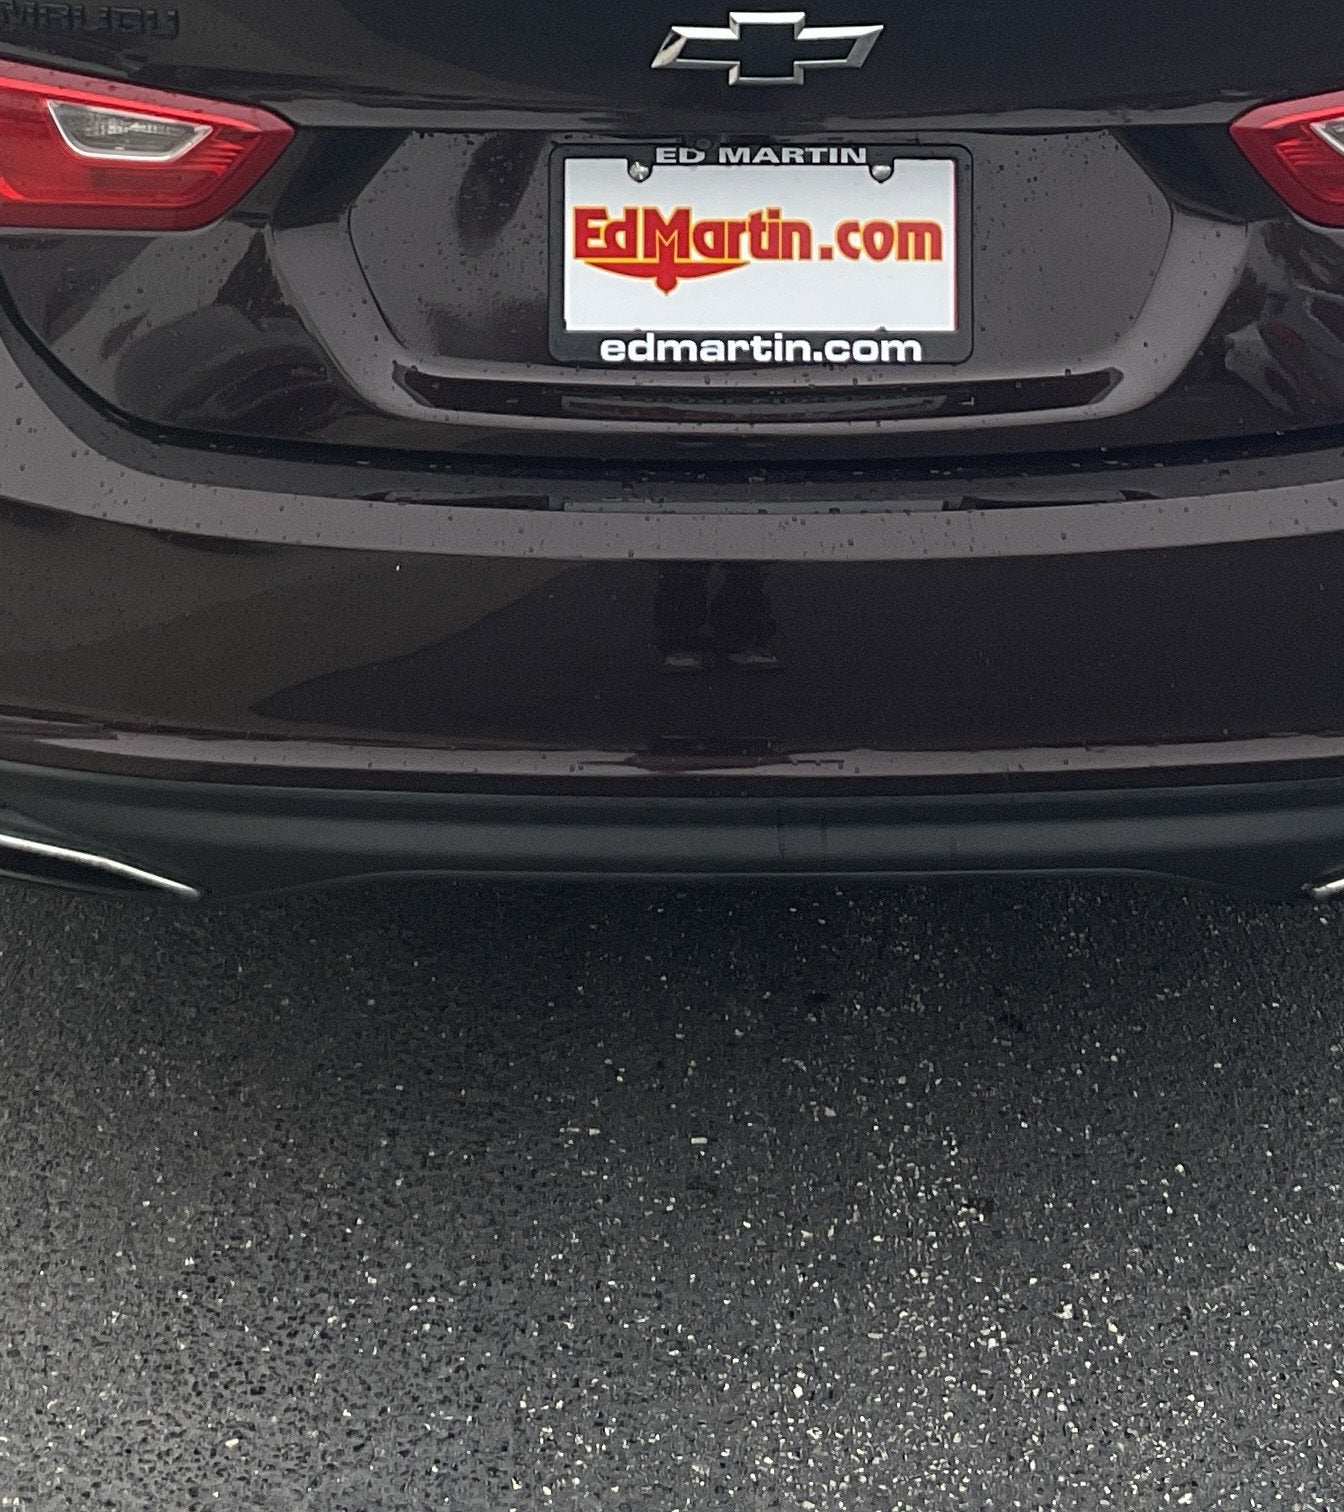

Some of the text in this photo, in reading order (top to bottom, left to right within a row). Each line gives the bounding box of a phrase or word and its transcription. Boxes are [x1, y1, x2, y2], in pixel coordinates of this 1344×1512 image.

[1, 0, 179, 40] MALIBU
[656, 147, 867, 164] ED MARTIN
[573, 206, 943, 263] EdMartin.com
[600, 332, 922, 363] edmartin.com
